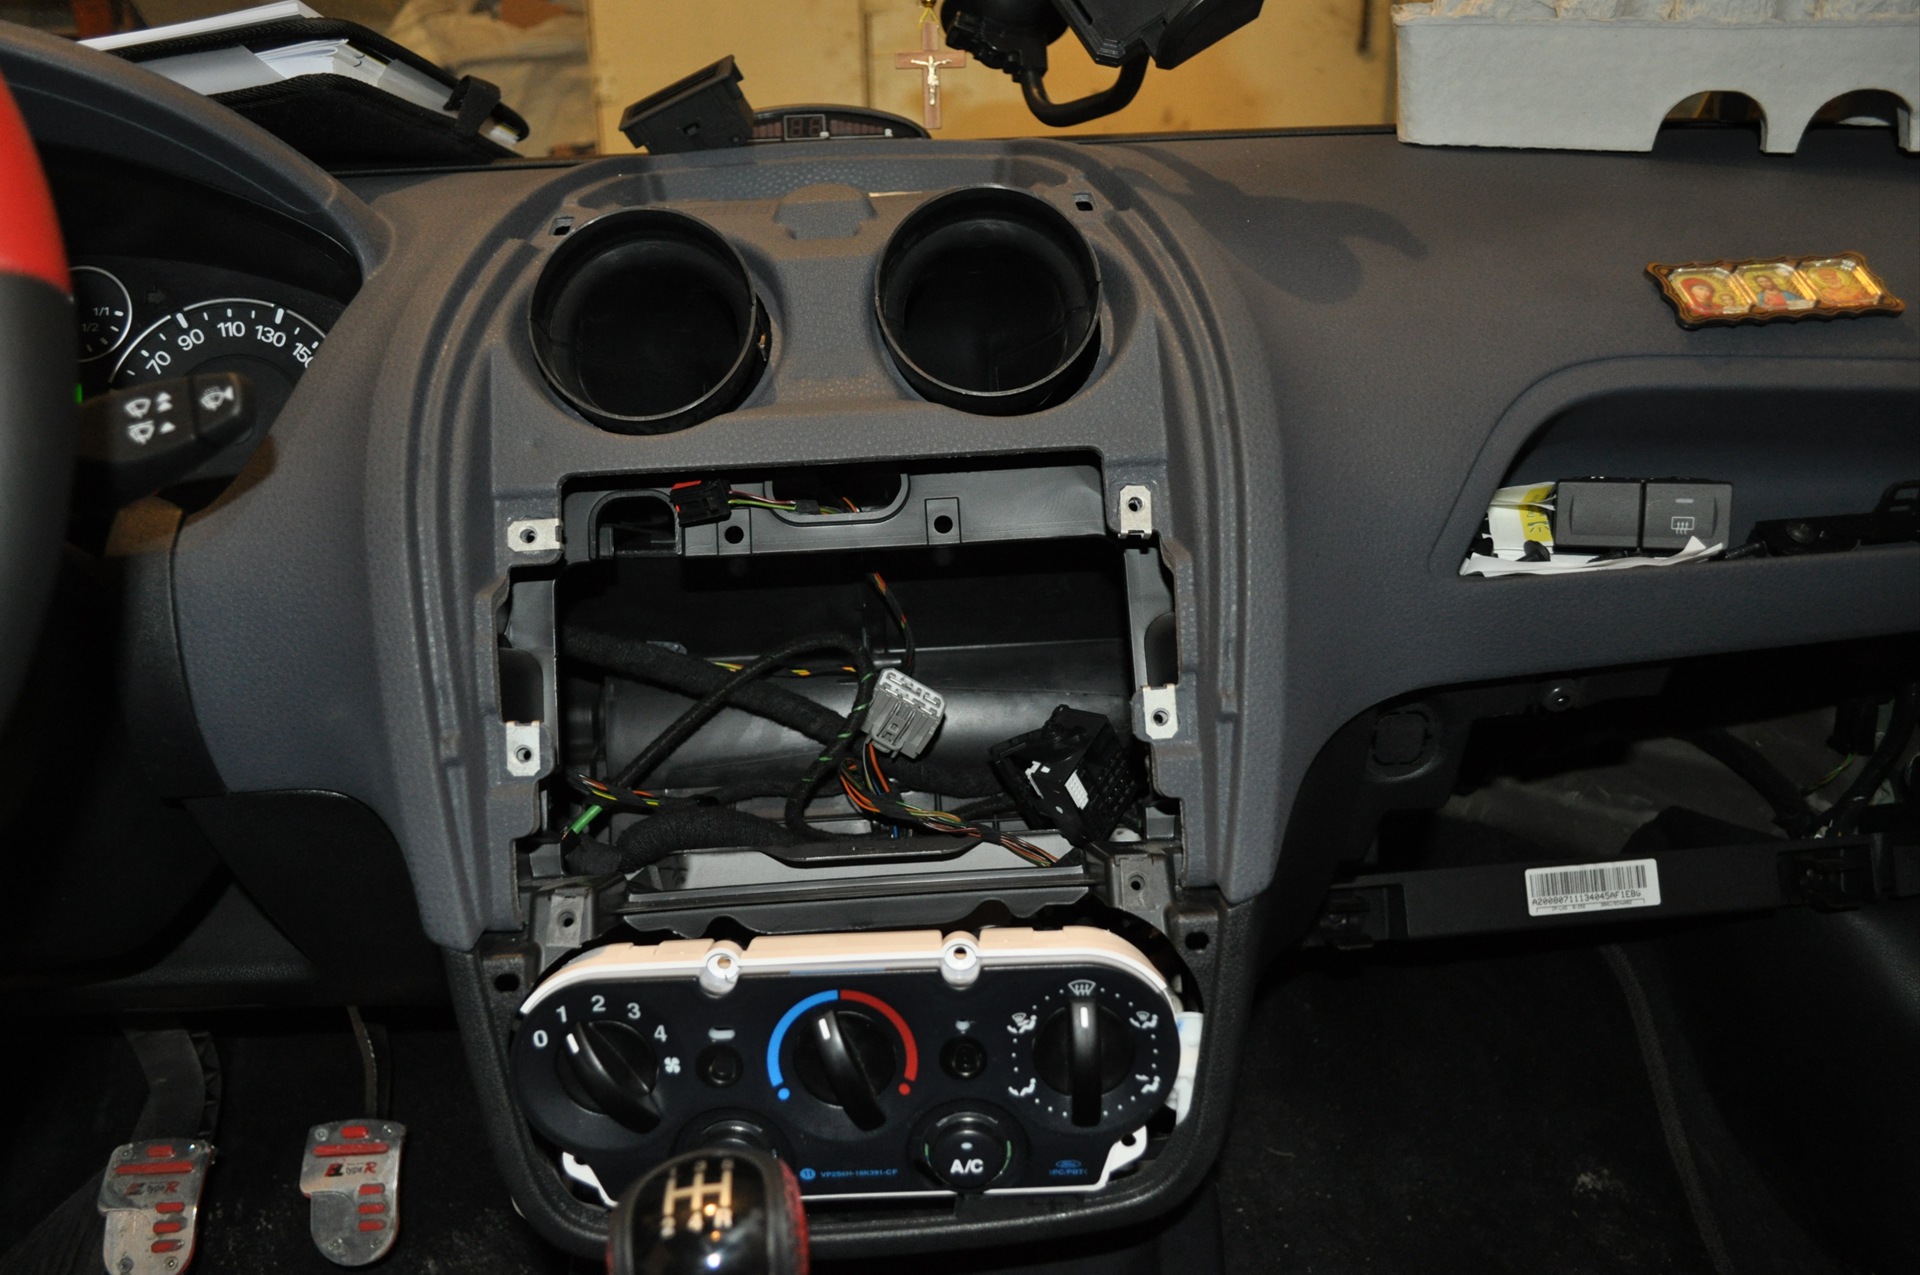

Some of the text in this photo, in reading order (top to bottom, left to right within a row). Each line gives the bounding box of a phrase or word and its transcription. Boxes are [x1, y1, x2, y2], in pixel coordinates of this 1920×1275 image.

[92, 308, 110, 317] 1/1
[217, 321, 246, 337] 110
[255, 325, 286, 347] 130
[178, 329, 205, 351] 90
[146, 351, 171, 375] 70
[591, 995, 606, 1012] 2
[627, 1003, 641, 1019] 3
[556, 1005, 567, 1023] 1
[533, 1030, 548, 1047] 0
[654, 1025, 667, 1042] 4
[950, 1159, 984, 1174] A/C
